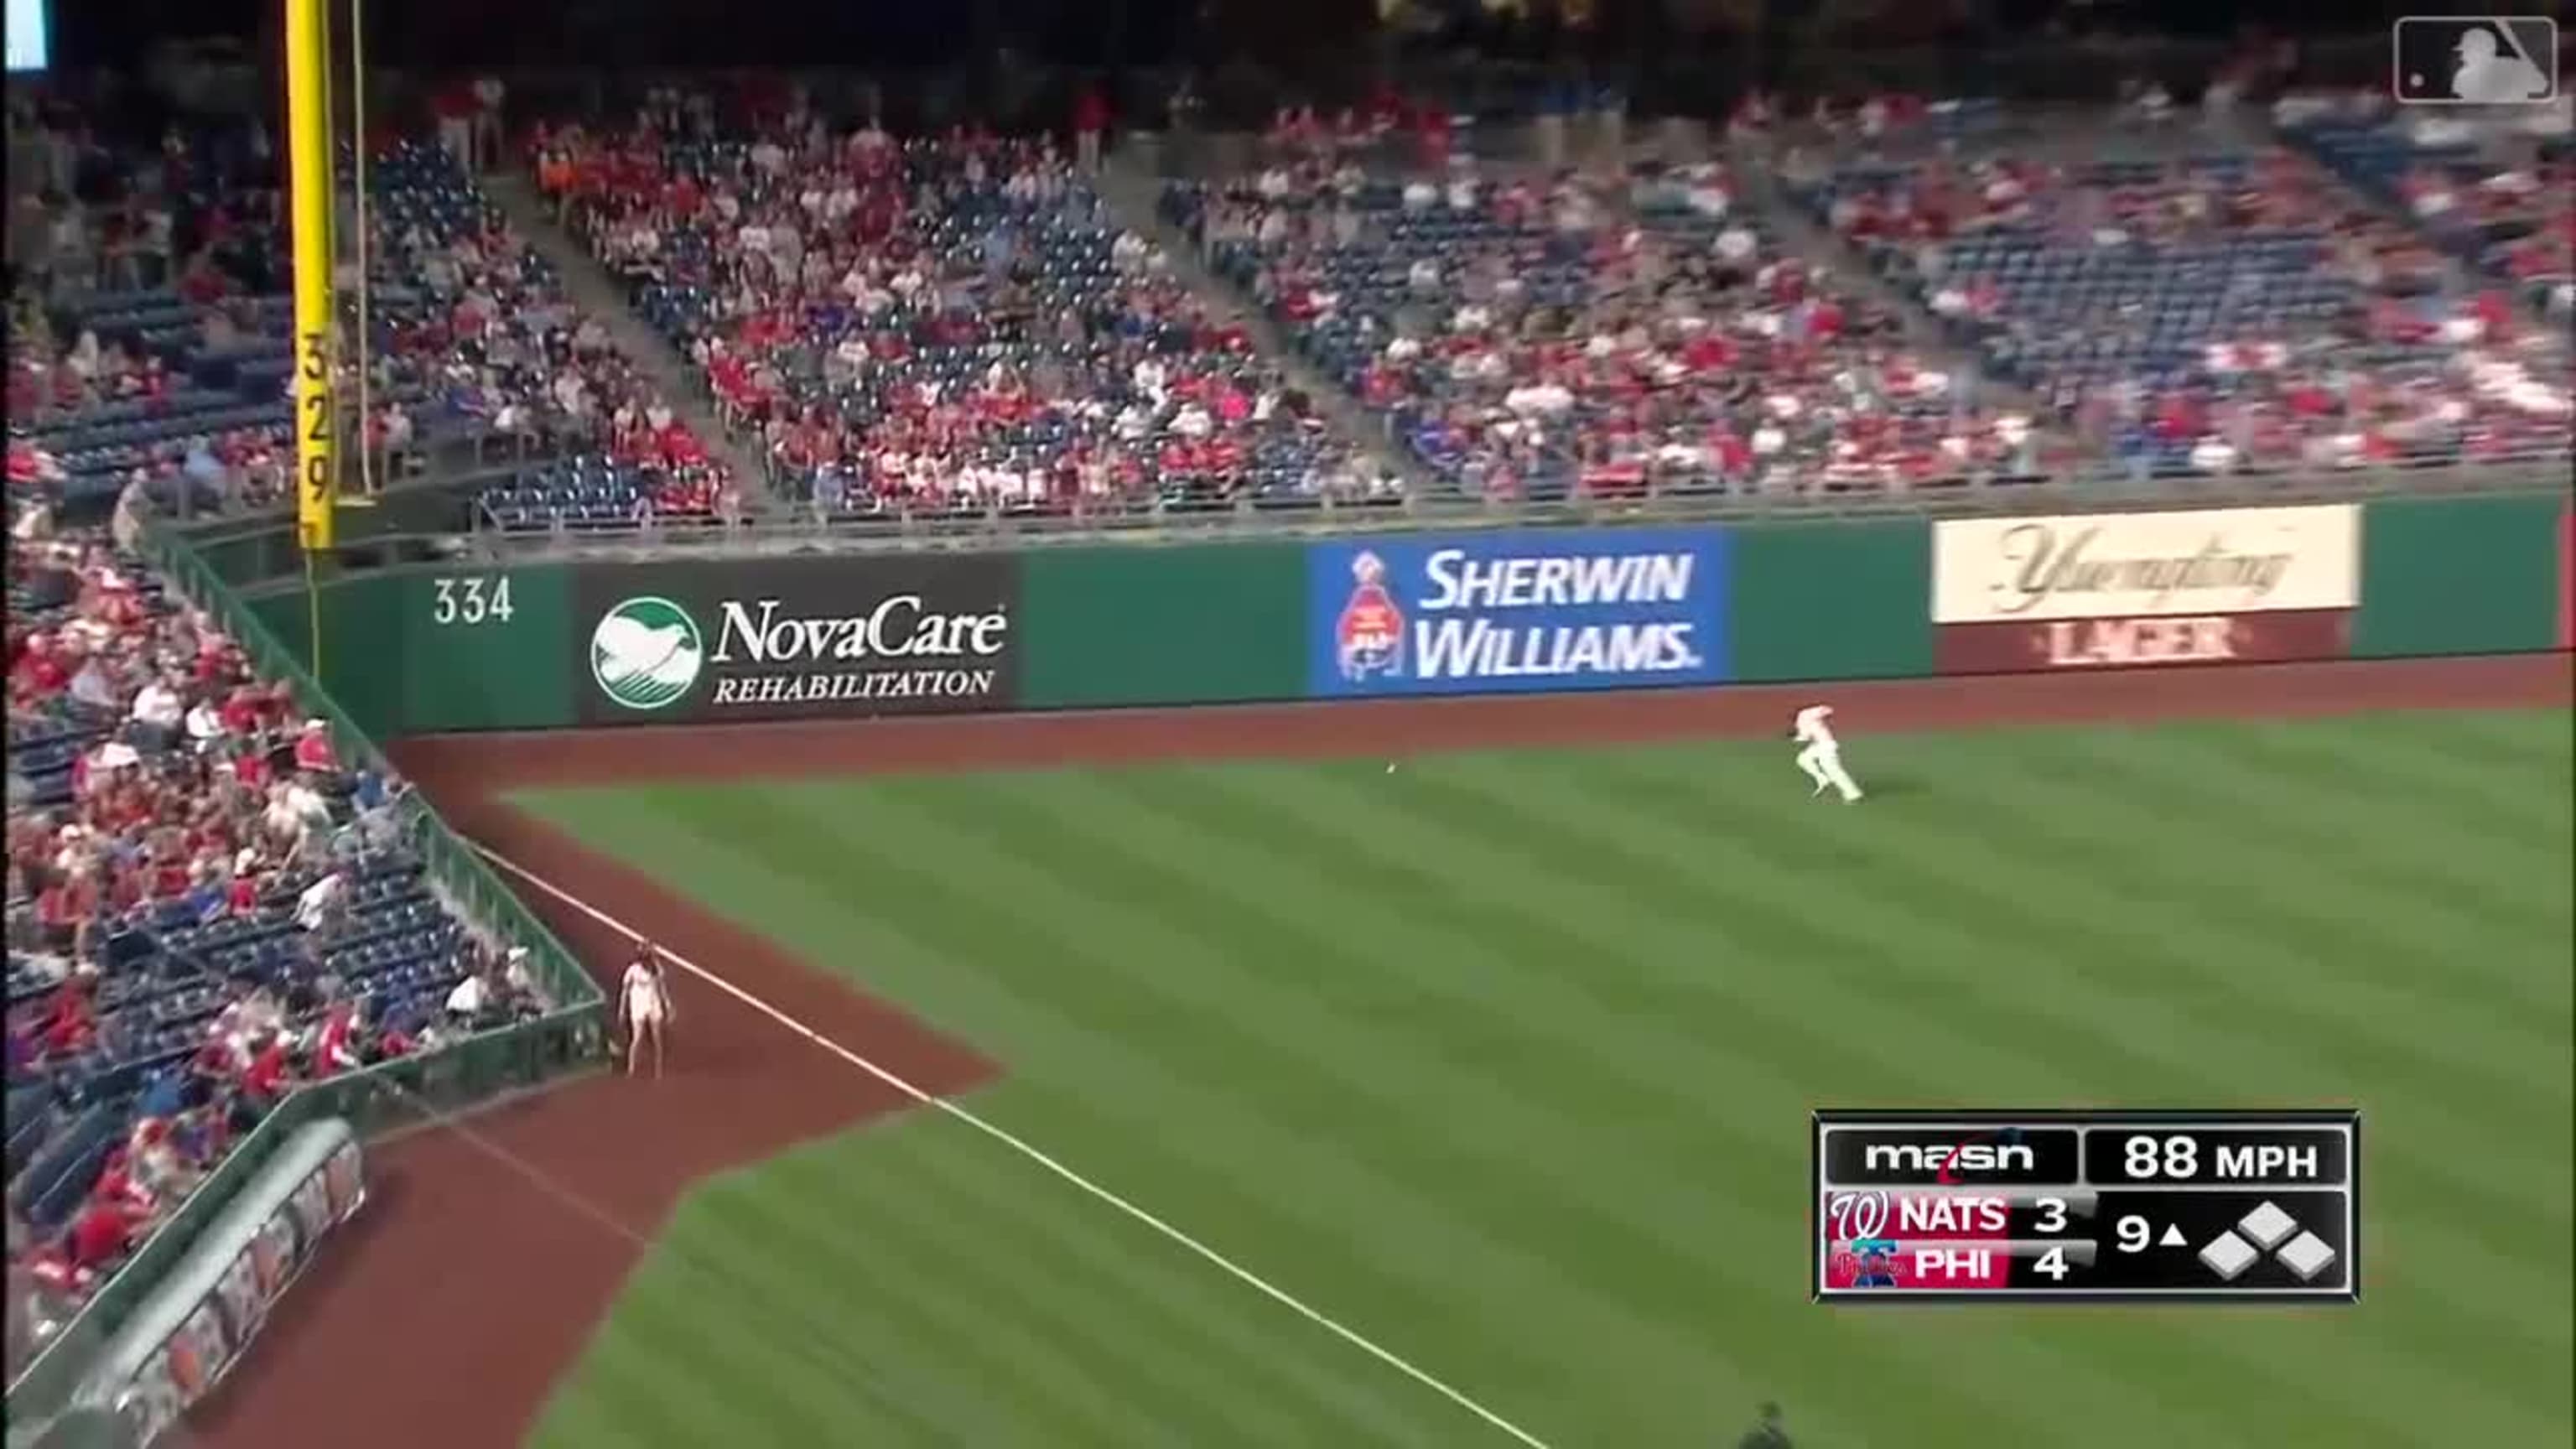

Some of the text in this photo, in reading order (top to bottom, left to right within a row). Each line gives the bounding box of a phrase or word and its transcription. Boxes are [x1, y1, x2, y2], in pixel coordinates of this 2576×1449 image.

[303, 332, 329, 502] 329
[433, 578, 513, 624] 334
[1419, 549, 1696, 610] SHERWIN
[711, 595, 1007, 662] NovaCare
[713, 669, 995, 704] REHABILITATION
